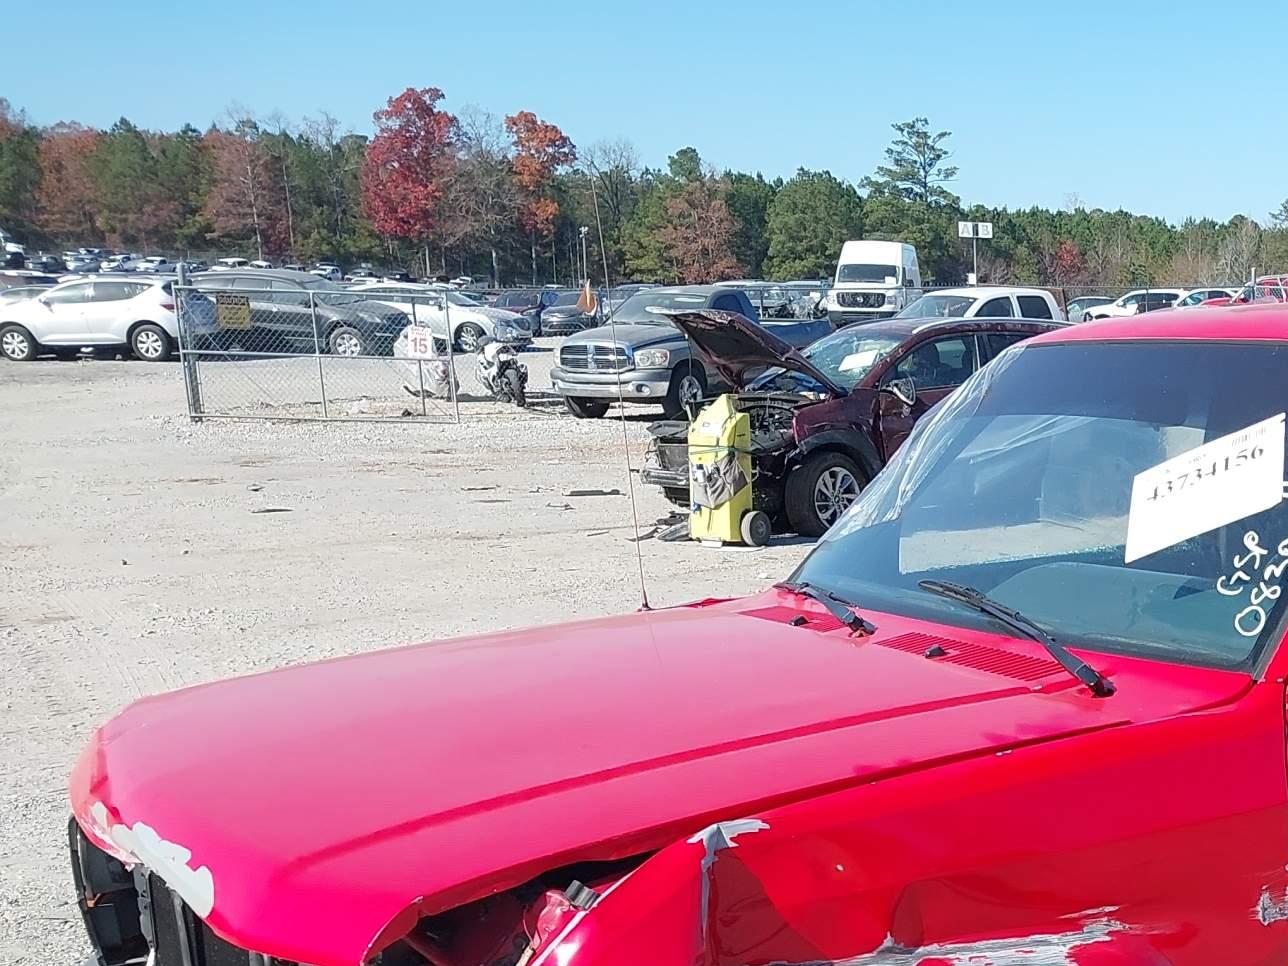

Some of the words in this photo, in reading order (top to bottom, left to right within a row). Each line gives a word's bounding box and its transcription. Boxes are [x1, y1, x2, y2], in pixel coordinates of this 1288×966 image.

[960, 223, 971, 236] A
[981, 224, 991, 236] B
[411, 337, 428, 354] 15
